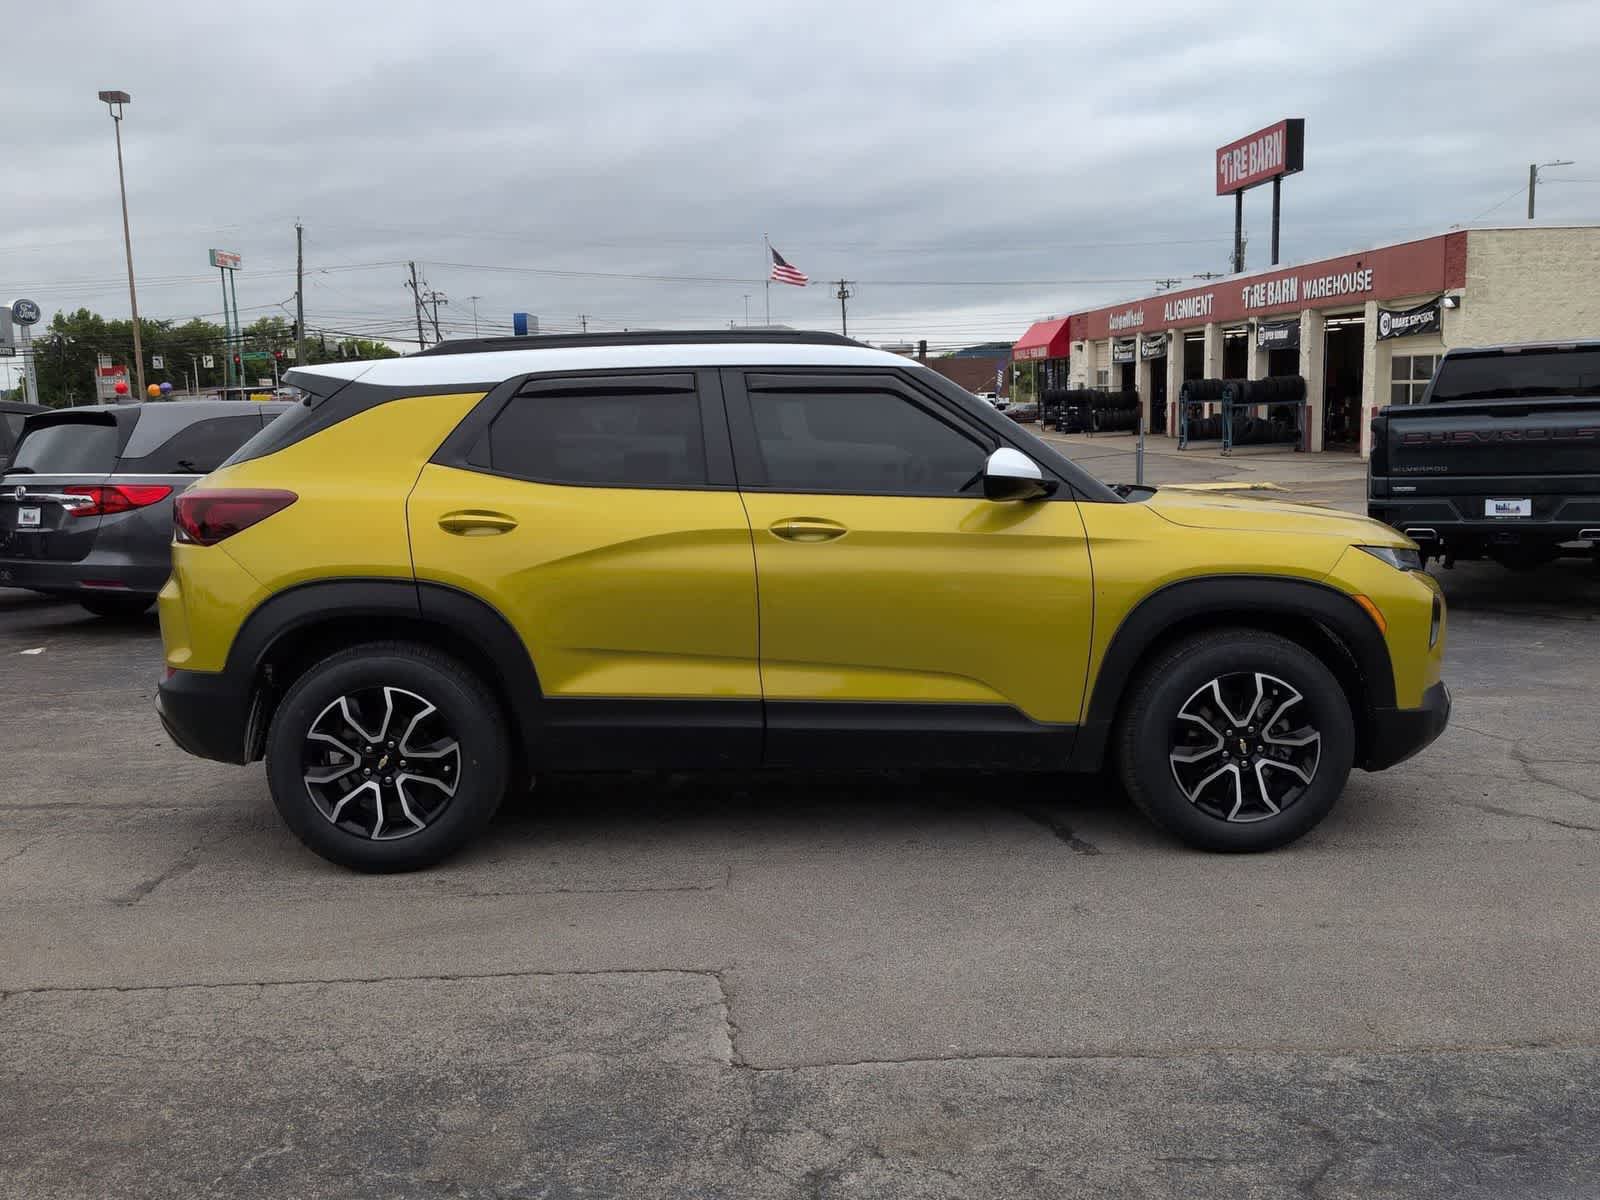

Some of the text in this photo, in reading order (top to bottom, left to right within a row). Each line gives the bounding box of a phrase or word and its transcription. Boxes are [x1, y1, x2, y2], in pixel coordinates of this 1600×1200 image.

[1249, 130, 1283, 177] BARN
[1267, 276, 1299, 306] BARN
[1302, 269, 1373, 300] WAREHOUSE
[1164, 294, 1213, 321] ALIGNMENT
[1402, 428, 1600, 445] CHEVROLE
